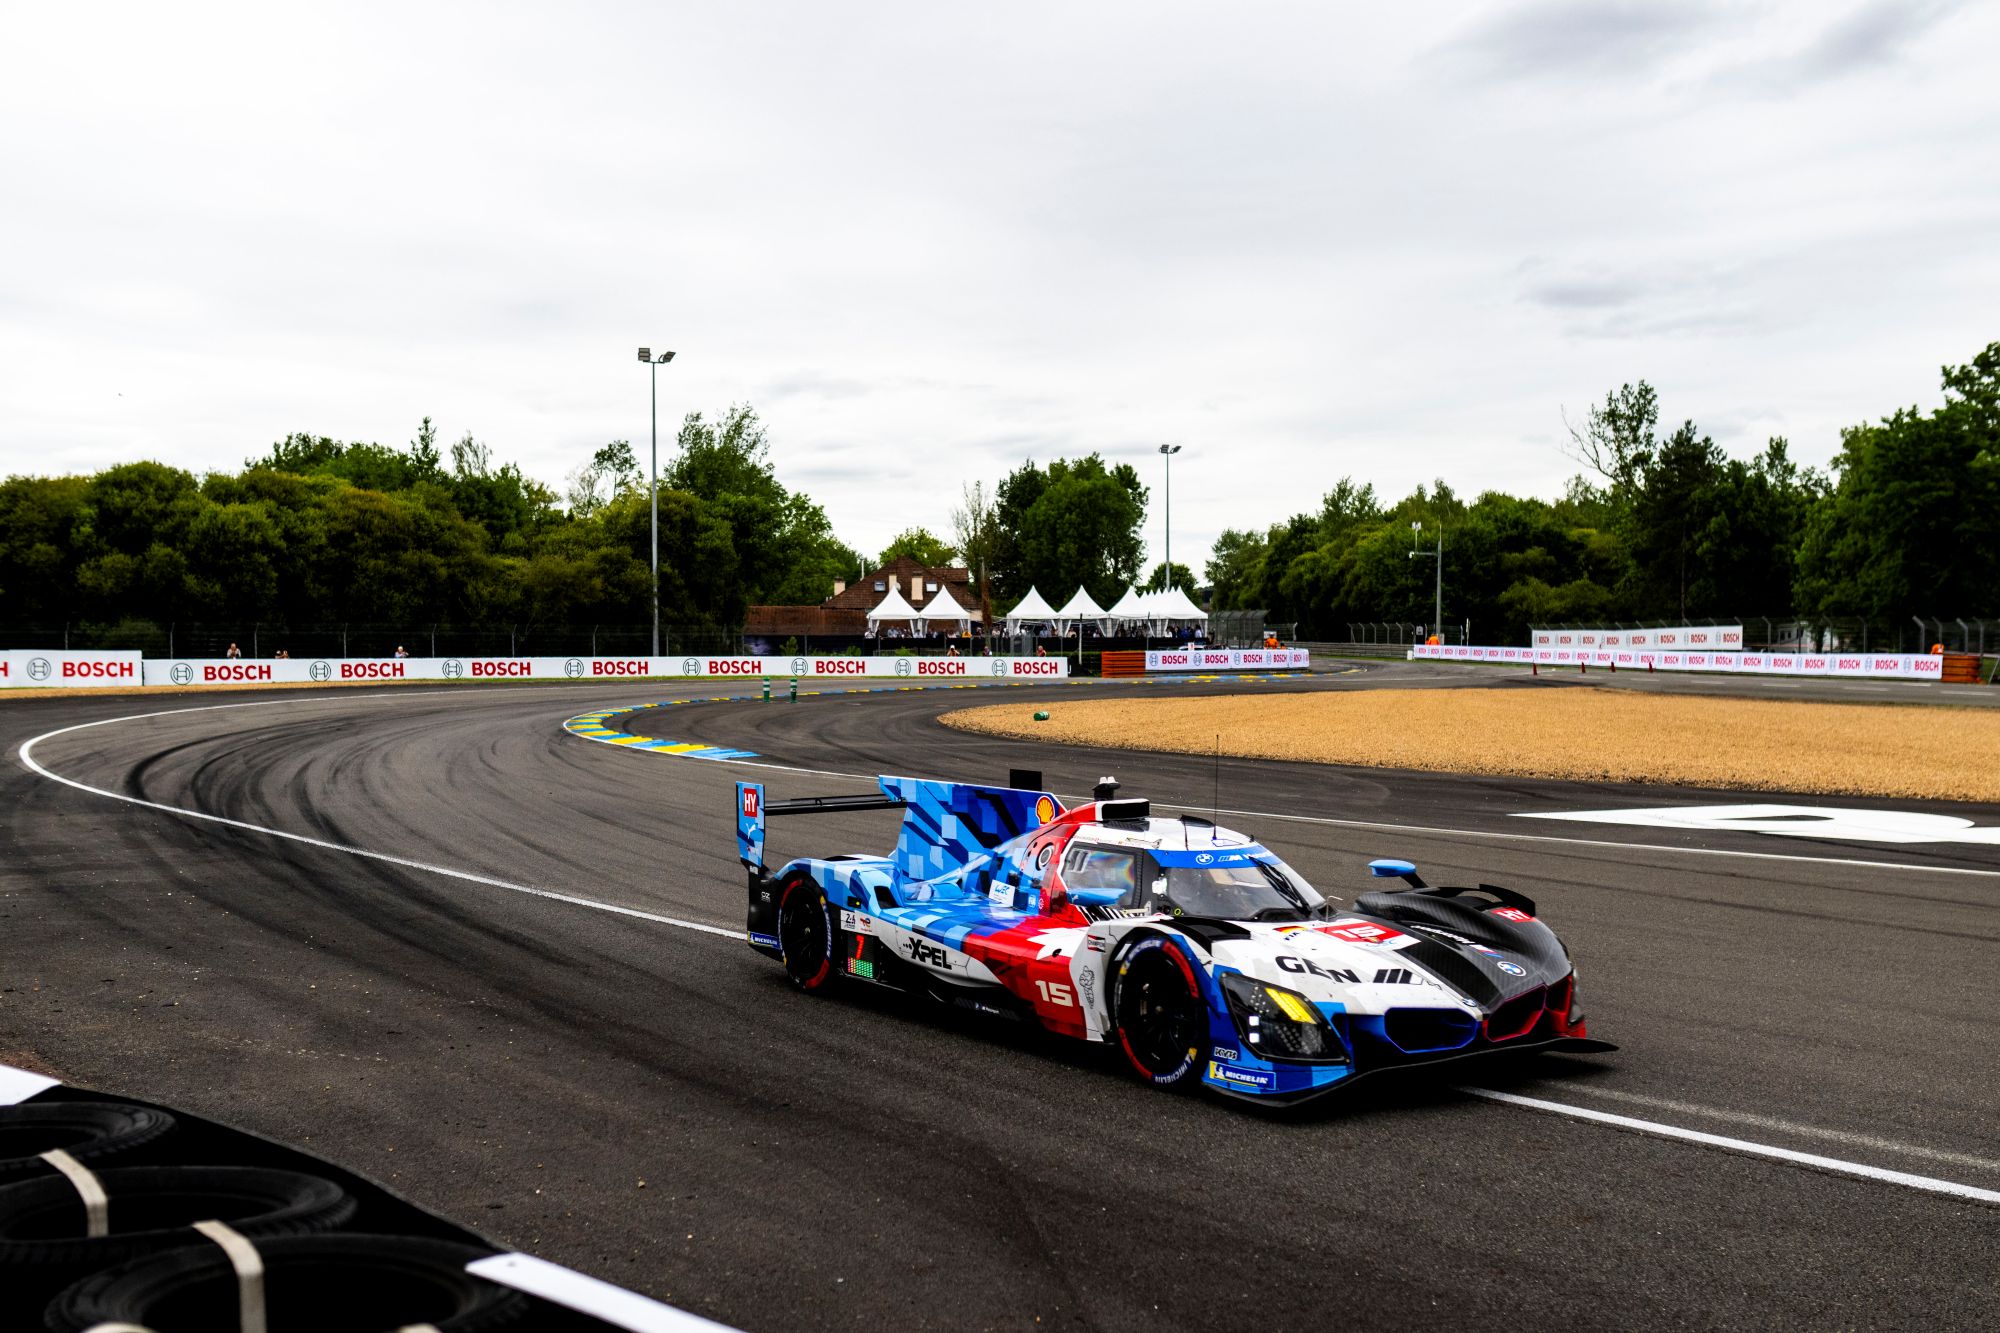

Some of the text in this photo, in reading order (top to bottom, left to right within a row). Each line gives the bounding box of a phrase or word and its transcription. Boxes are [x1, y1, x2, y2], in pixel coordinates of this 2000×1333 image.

[1660, 635, 1675, 643] BOSCH
[1690, 633, 1707, 643] BOSCH
[1723, 633, 1739, 643] BOSCH
[1161, 655, 1188, 665] BOSCH
[1204, 655, 1229, 664] BOSCH
[1243, 654, 1262, 663] BOSCH
[1664, 656, 1679, 664] BOSCH
[1689, 656, 1705, 664] BOSCH
[1716, 656, 1732, 665] BOSCH
[1744, 657, 1761, 666] BOSCH
[1773, 658, 1792, 668] BOSCH
[1805, 658, 1825, 669] BOSCH
[1839, 659, 1860, 670] BOSCH
[63, 661, 133, 678] BOSCH
[341, 663, 404, 679] BOSCH
[472, 662, 531, 677] BOSCH
[593, 661, 648, 675] BOSCH
[709, 660, 761, 674] BOSCH
[816, 660, 865, 674] BOSCH
[918, 661, 965, 675] BOSCH
[1014, 661, 1058, 675] BOSCH
[1875, 660, 1898, 670] BOSCH
[1914, 660, 1939, 672] BOSCH
[204, 664, 271, 681] BOSCH
[744, 793, 757, 813] HY
[1497, 909, 1531, 920] HY
[1332, 926, 1386, 939] 15
[908, 937, 952, 970] XPEL
[1275, 956, 1362, 984] GEN
[1035, 980, 1073, 1007] 15
[1225, 1070, 1268, 1084] MICHELIN
